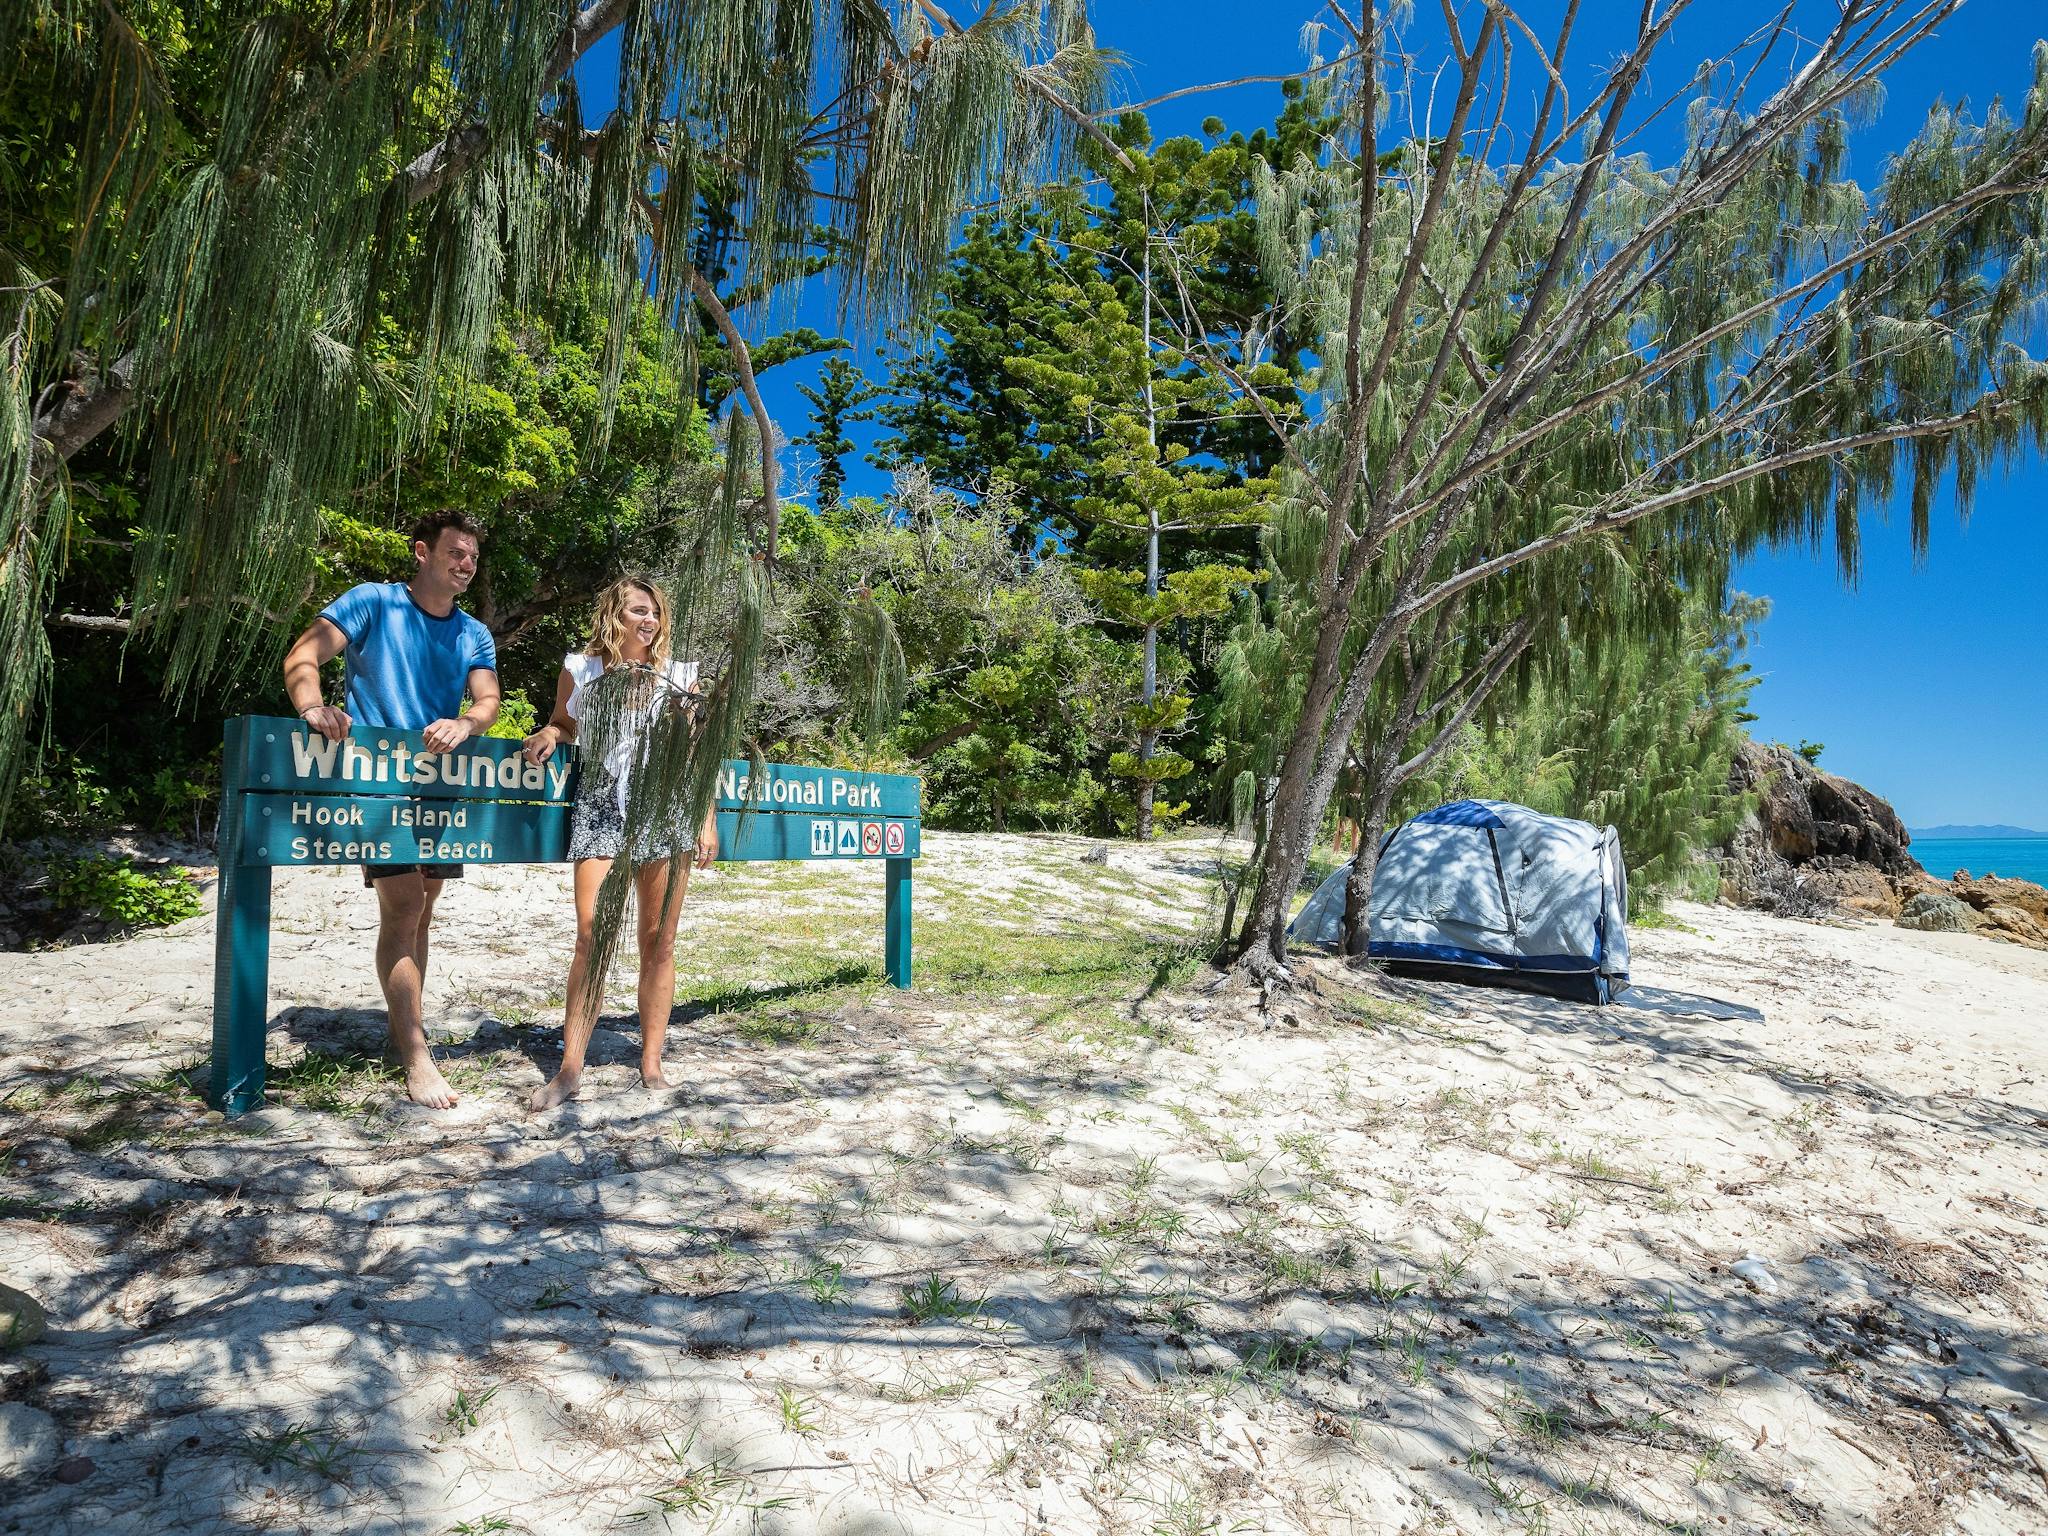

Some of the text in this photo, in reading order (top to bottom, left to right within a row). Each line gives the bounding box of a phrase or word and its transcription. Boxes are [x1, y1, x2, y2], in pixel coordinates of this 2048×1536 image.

[290, 731, 571, 800] Whitsunday
[831, 777, 882, 808] Park
[291, 801, 467, 828] Hook Island
[291, 836, 493, 860] Steens Beach
